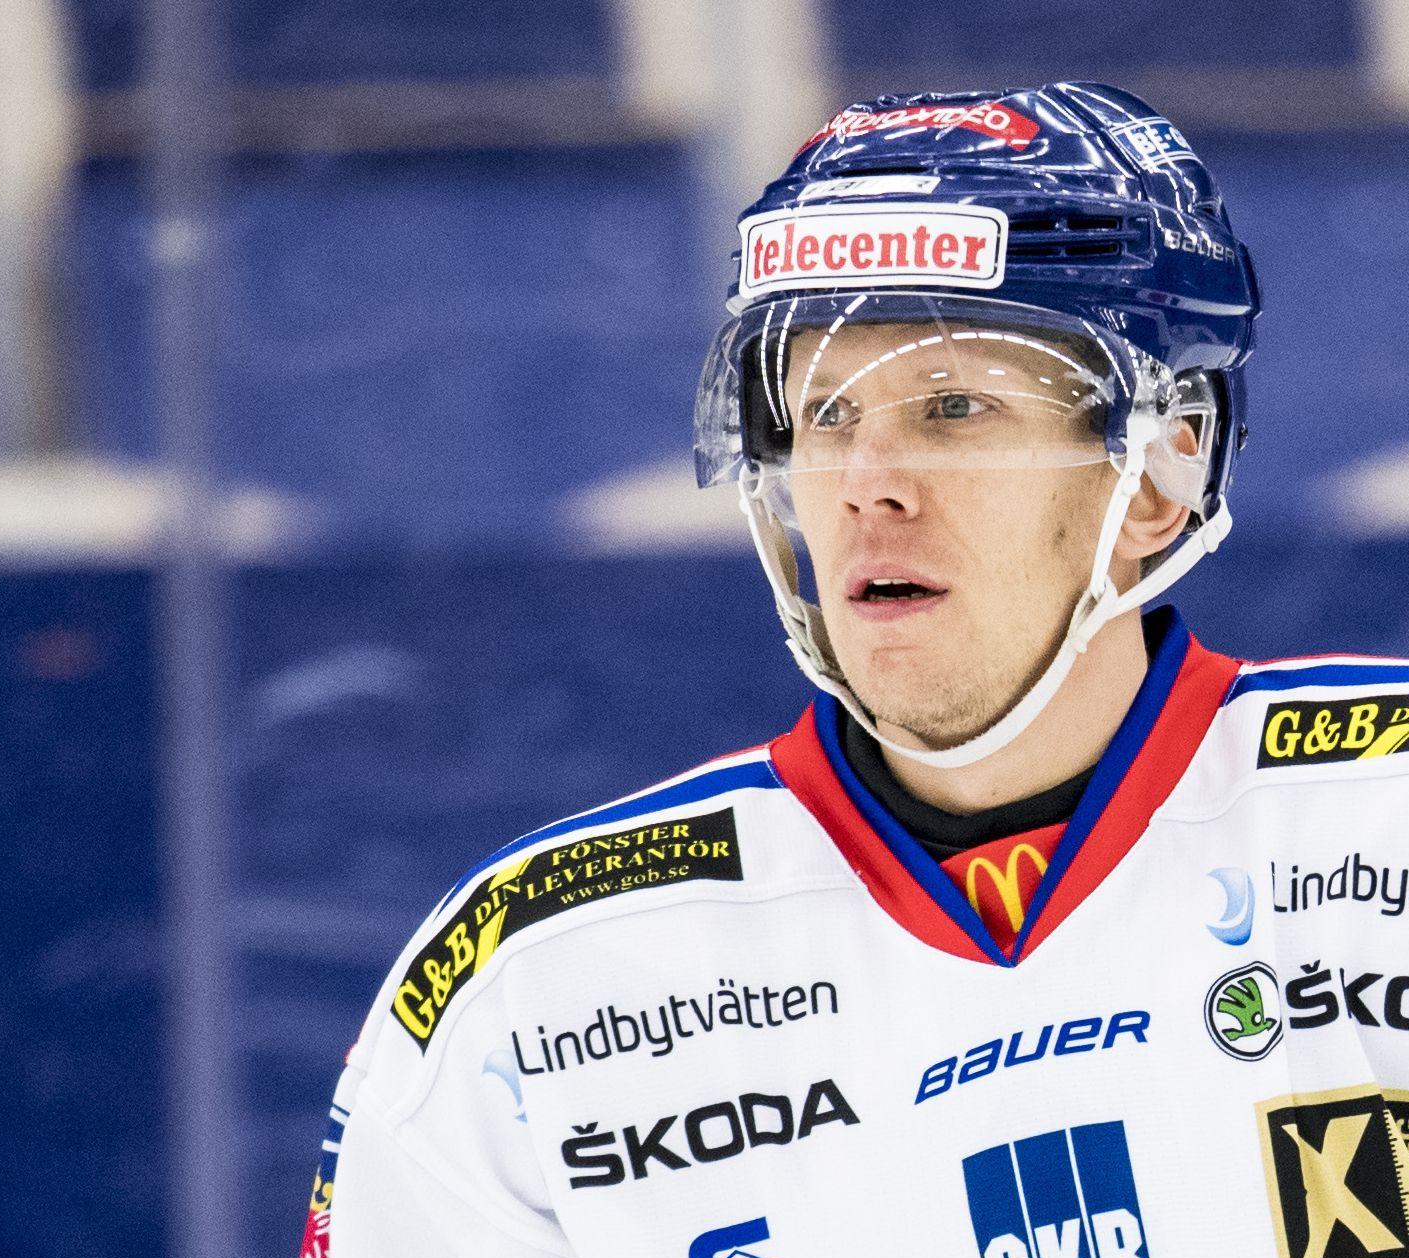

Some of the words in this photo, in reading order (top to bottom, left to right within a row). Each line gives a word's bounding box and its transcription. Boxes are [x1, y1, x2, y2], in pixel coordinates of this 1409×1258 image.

[753, 223, 987, 280] telecenter
[1265, 702, 1381, 759] G&B
[526, 839, 731, 901] LEVERANTÖR
[552, 823, 691, 867] FÖNSTER
[474, 879, 521, 926] DIN
[560, 862, 691, 905] www.gob.se
[393, 921, 476, 1041] G&B
[512, 978, 840, 1076] Lindbytvätten
[560, 1078, 862, 1190] ŠKODA
